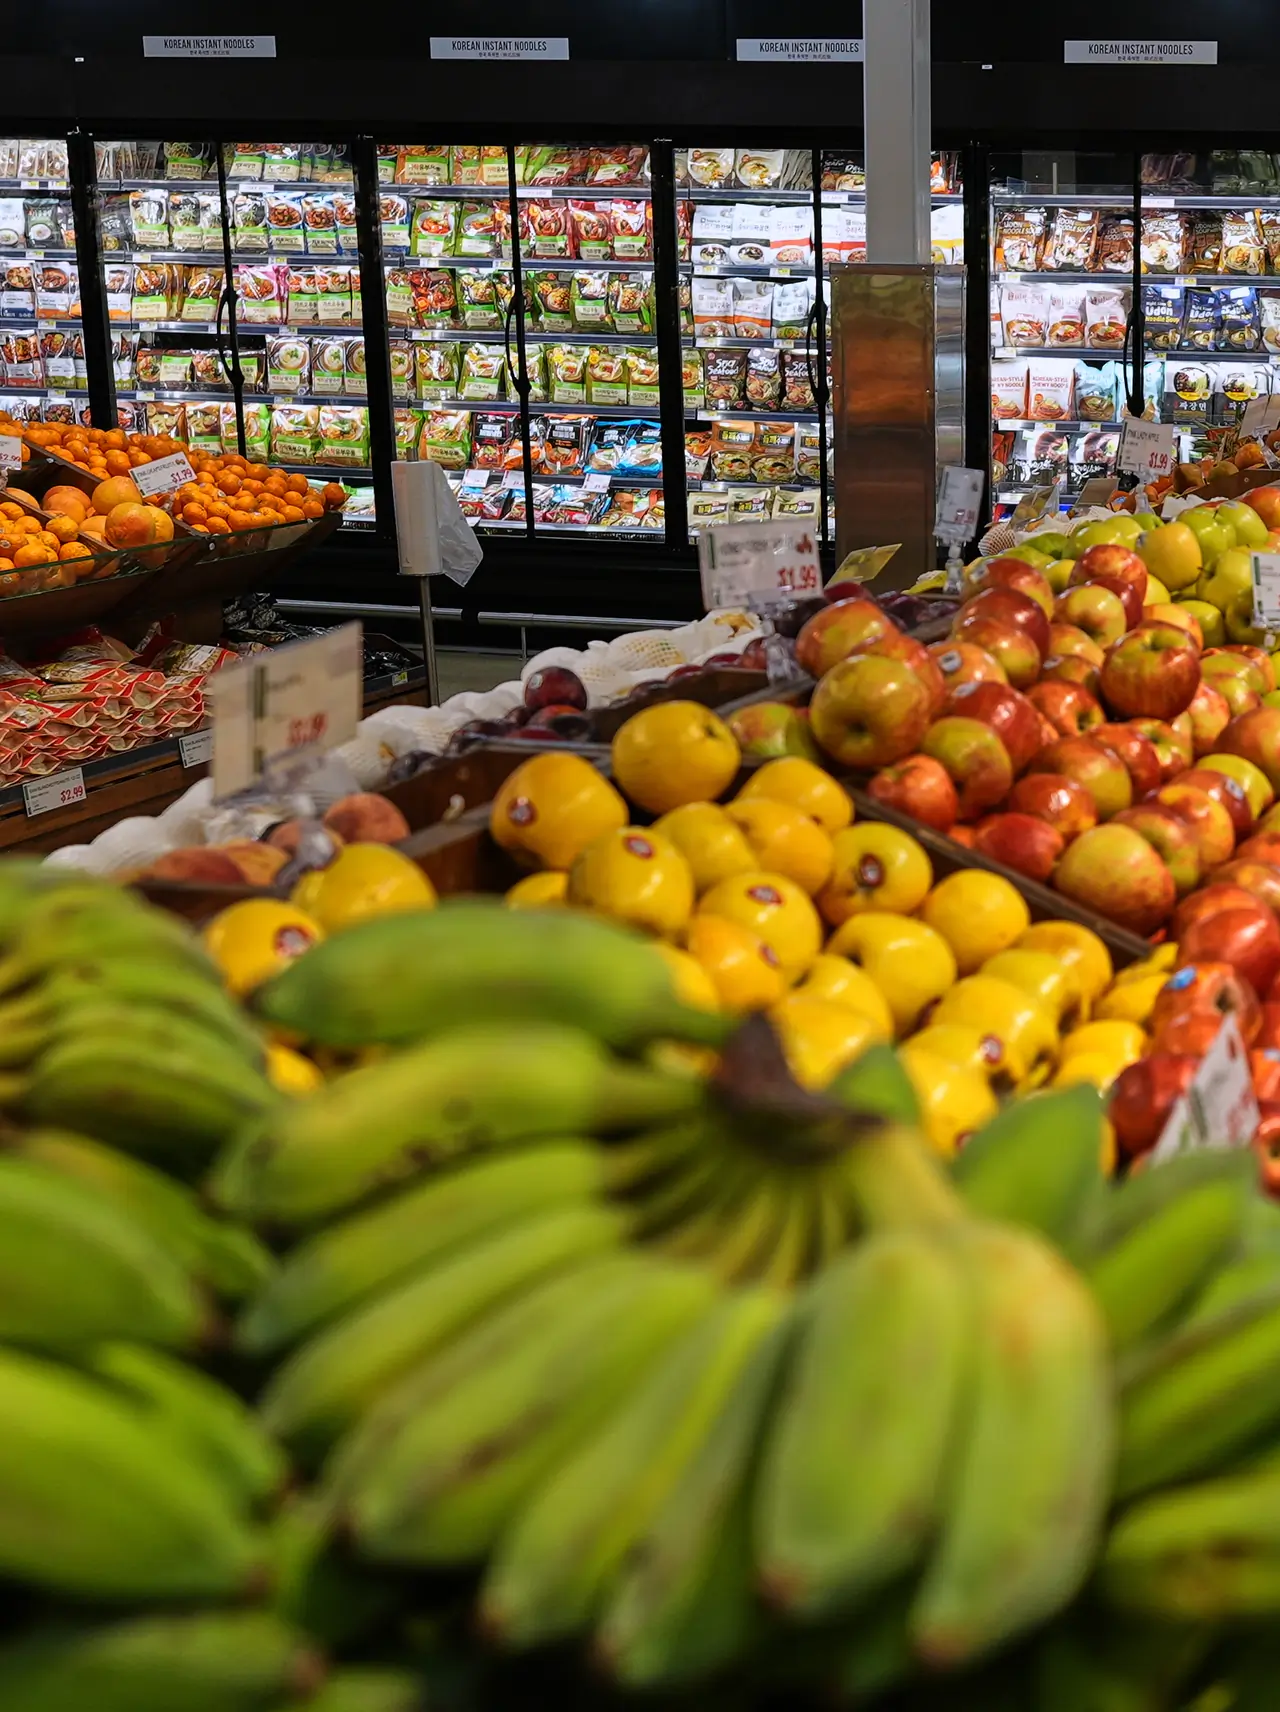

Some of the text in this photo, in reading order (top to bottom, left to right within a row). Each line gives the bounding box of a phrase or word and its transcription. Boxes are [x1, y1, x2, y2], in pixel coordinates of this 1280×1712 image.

[164, 39, 254, 49] KOREAN INSTANT NOODLES
[452, 41, 546, 50] KOREAN INSTANT NOODLES
[760, 43, 859, 52] KOREAN INSTANT NOODLES
[1089, 44, 1193, 54] KOREAN INSTANT NOODLES
[1145, 305, 1173, 316] Udon
[1149, 452, 1168, 469] $1.99
[171, 468, 192, 484] $1.79
[777, 565, 818, 591] $1.99
[60, 785, 83, 803] $2.49
